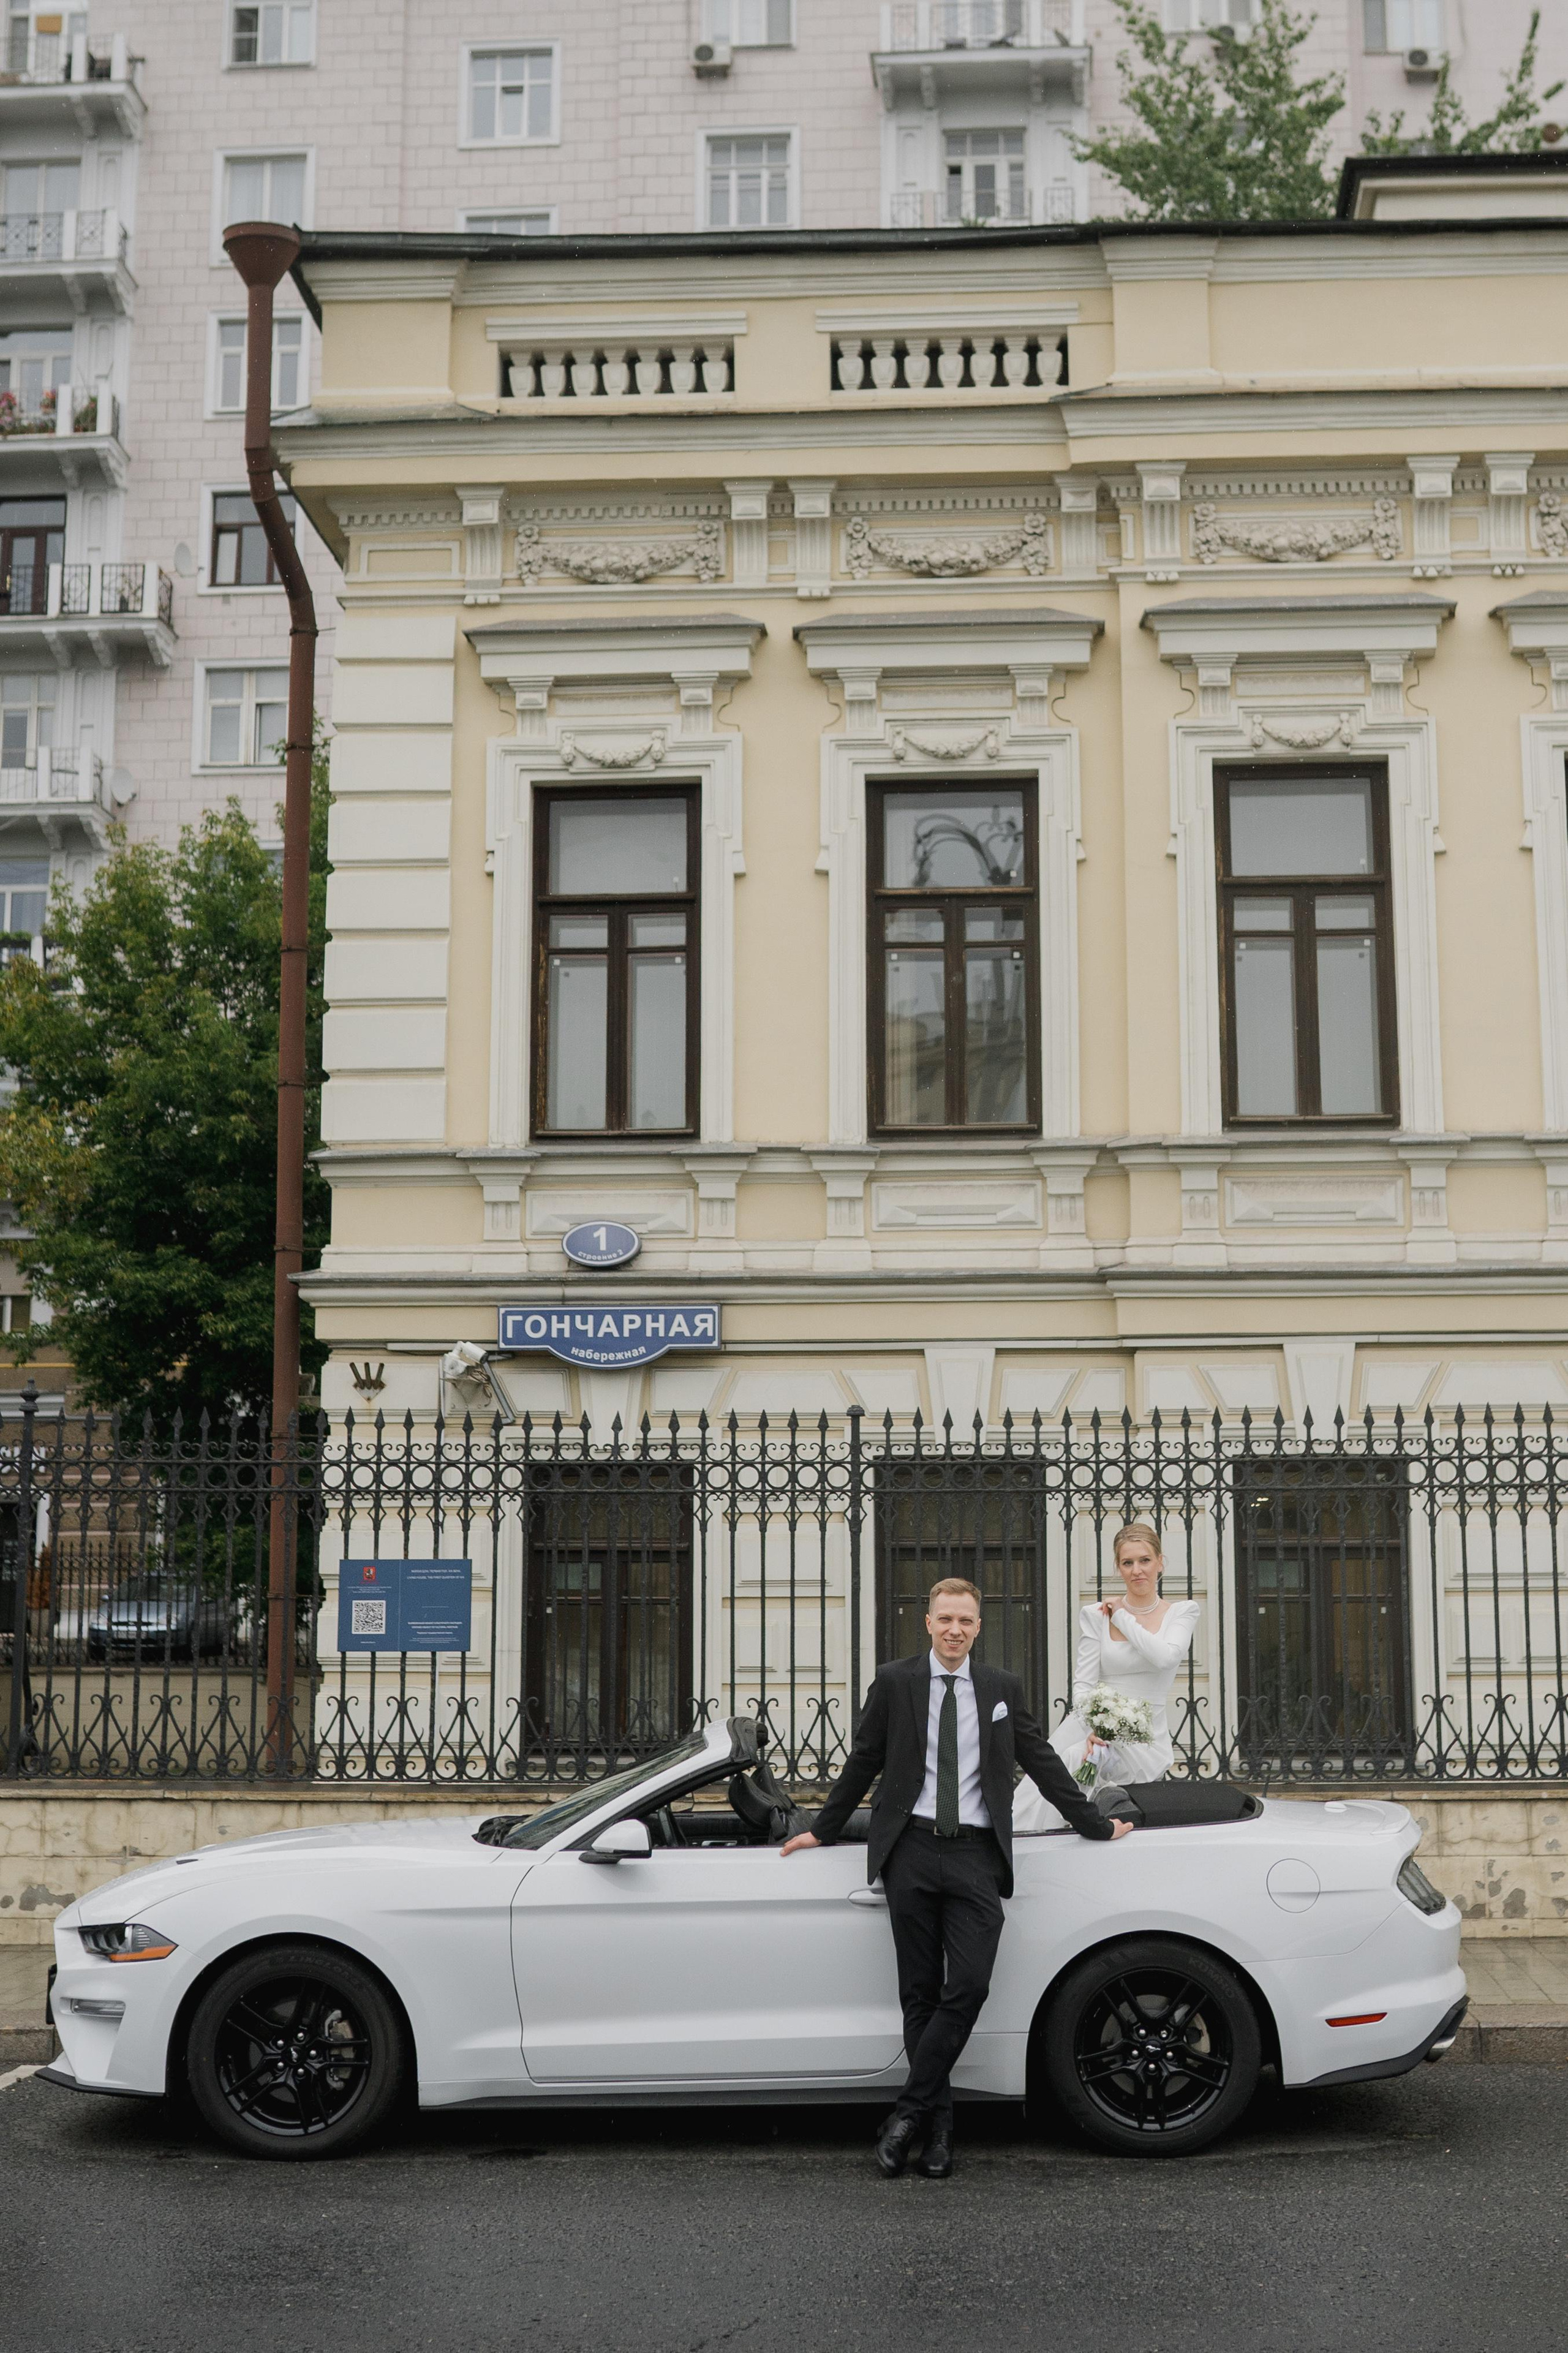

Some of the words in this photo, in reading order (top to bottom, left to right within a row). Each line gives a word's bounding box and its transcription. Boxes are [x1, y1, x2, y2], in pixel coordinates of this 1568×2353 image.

[592, 1226, 607, 1252] 1
[577, 1250, 618, 1261] строение
[507, 1313, 714, 1338] ГОНЧАРНАЯ
[571, 1346, 646, 1362] набережная
[1188, 1957, 1235, 1998] KUMHO
